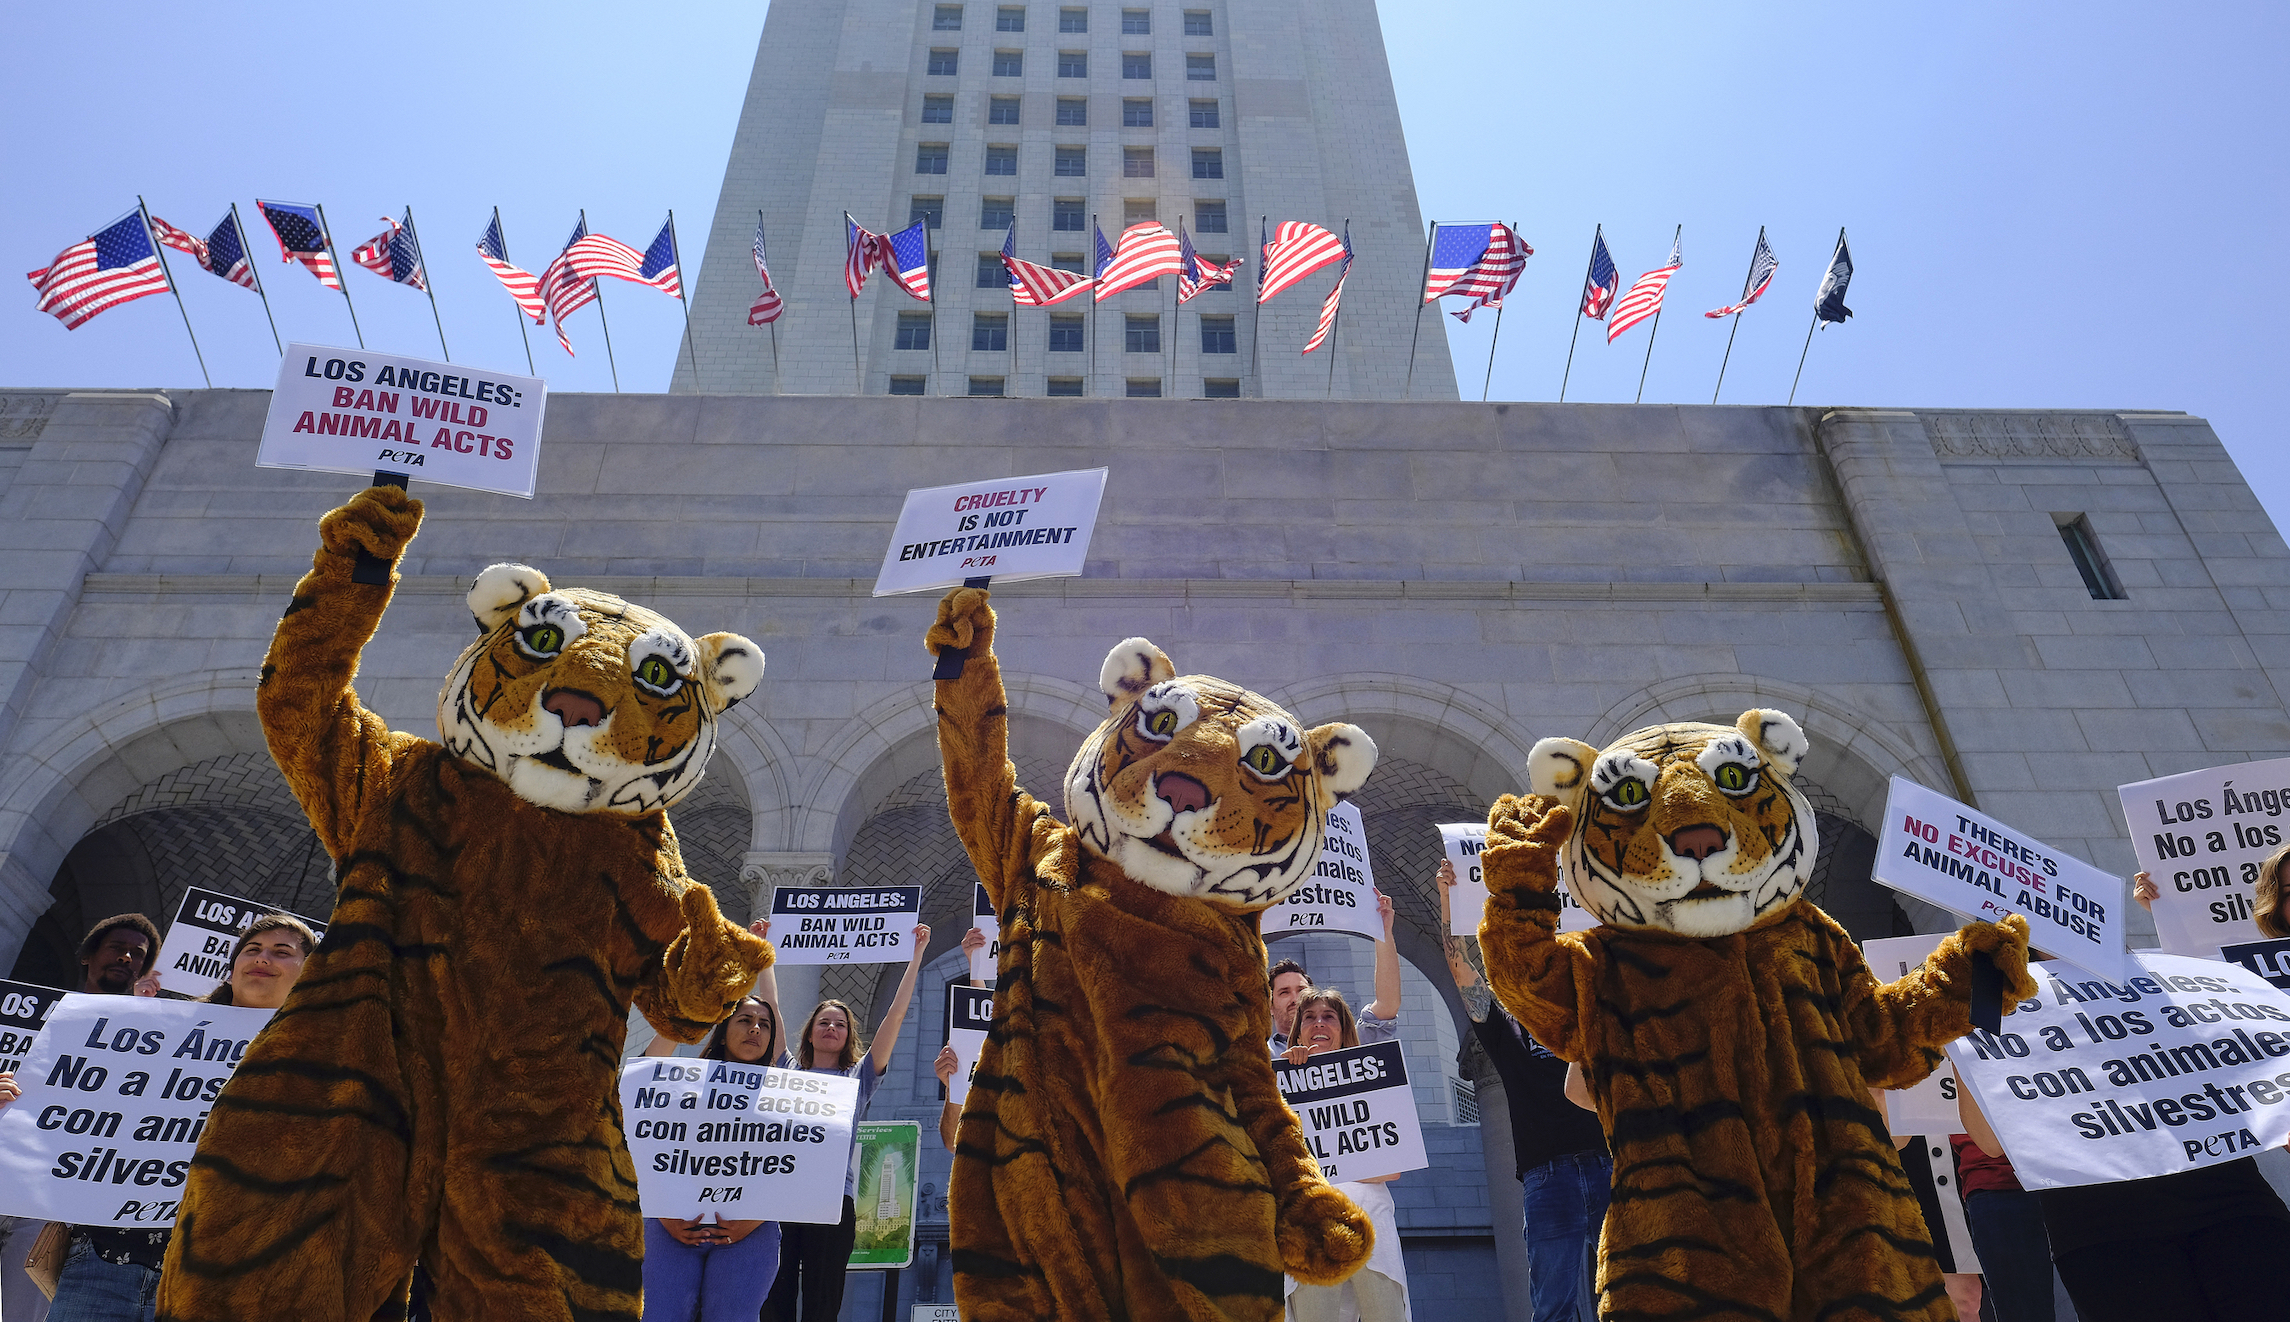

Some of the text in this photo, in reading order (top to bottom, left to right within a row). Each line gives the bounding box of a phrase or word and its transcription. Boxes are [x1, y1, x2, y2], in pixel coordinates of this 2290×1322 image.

[305, 356, 523, 408] LOS ANGELES:
[332, 386, 489, 428] BAN WILD
[292, 410, 514, 461] ANIMAL ACTS
[953, 486, 1049, 513] CRUELTY
[957, 509, 1029, 532] IS NOT
[899, 527, 1078, 562] ENTERTAINMENT
[2155, 798, 2214, 826] Los
[1956, 814, 2058, 877] THERE'S
[2153, 832, 2196, 860] No
[2205, 831, 2227, 853] a
[2233, 822, 2282, 849] los
[1903, 815, 2106, 925] NO EXCUSE FOR
[2173, 864, 2232, 893] con
[786, 892, 906, 910] LOS ANGELES:
[1903, 841, 2102, 945] ANIMAL ABUSE
[194, 899, 237, 926] LOS
[800, 917, 885, 933] BAN WILD
[780, 932, 900, 949] ANIMAL ACTS
[0, 992, 39, 1019] OS
[84, 1017, 165, 1055] Los
[1964, 998, 2290, 1060] No a los actos
[45, 1054, 109, 1092] No
[118, 1071, 150, 1097] a
[160, 1067, 226, 1102] los
[652, 1061, 702, 1083] Los
[1276, 1055, 1387, 1095] ANGELES:
[2005, 1064, 2096, 1101] con
[634, 1087, 837, 1118] No a los actos
[1308, 1099, 1371, 1131] WILD
[36, 1105, 123, 1138] con
[635, 1117, 826, 1144] con animales
[1338, 1121, 1399, 1156] ACTS
[652, 1148, 797, 1177] silvestres
[934, 1309, 957, 1317] CITY
